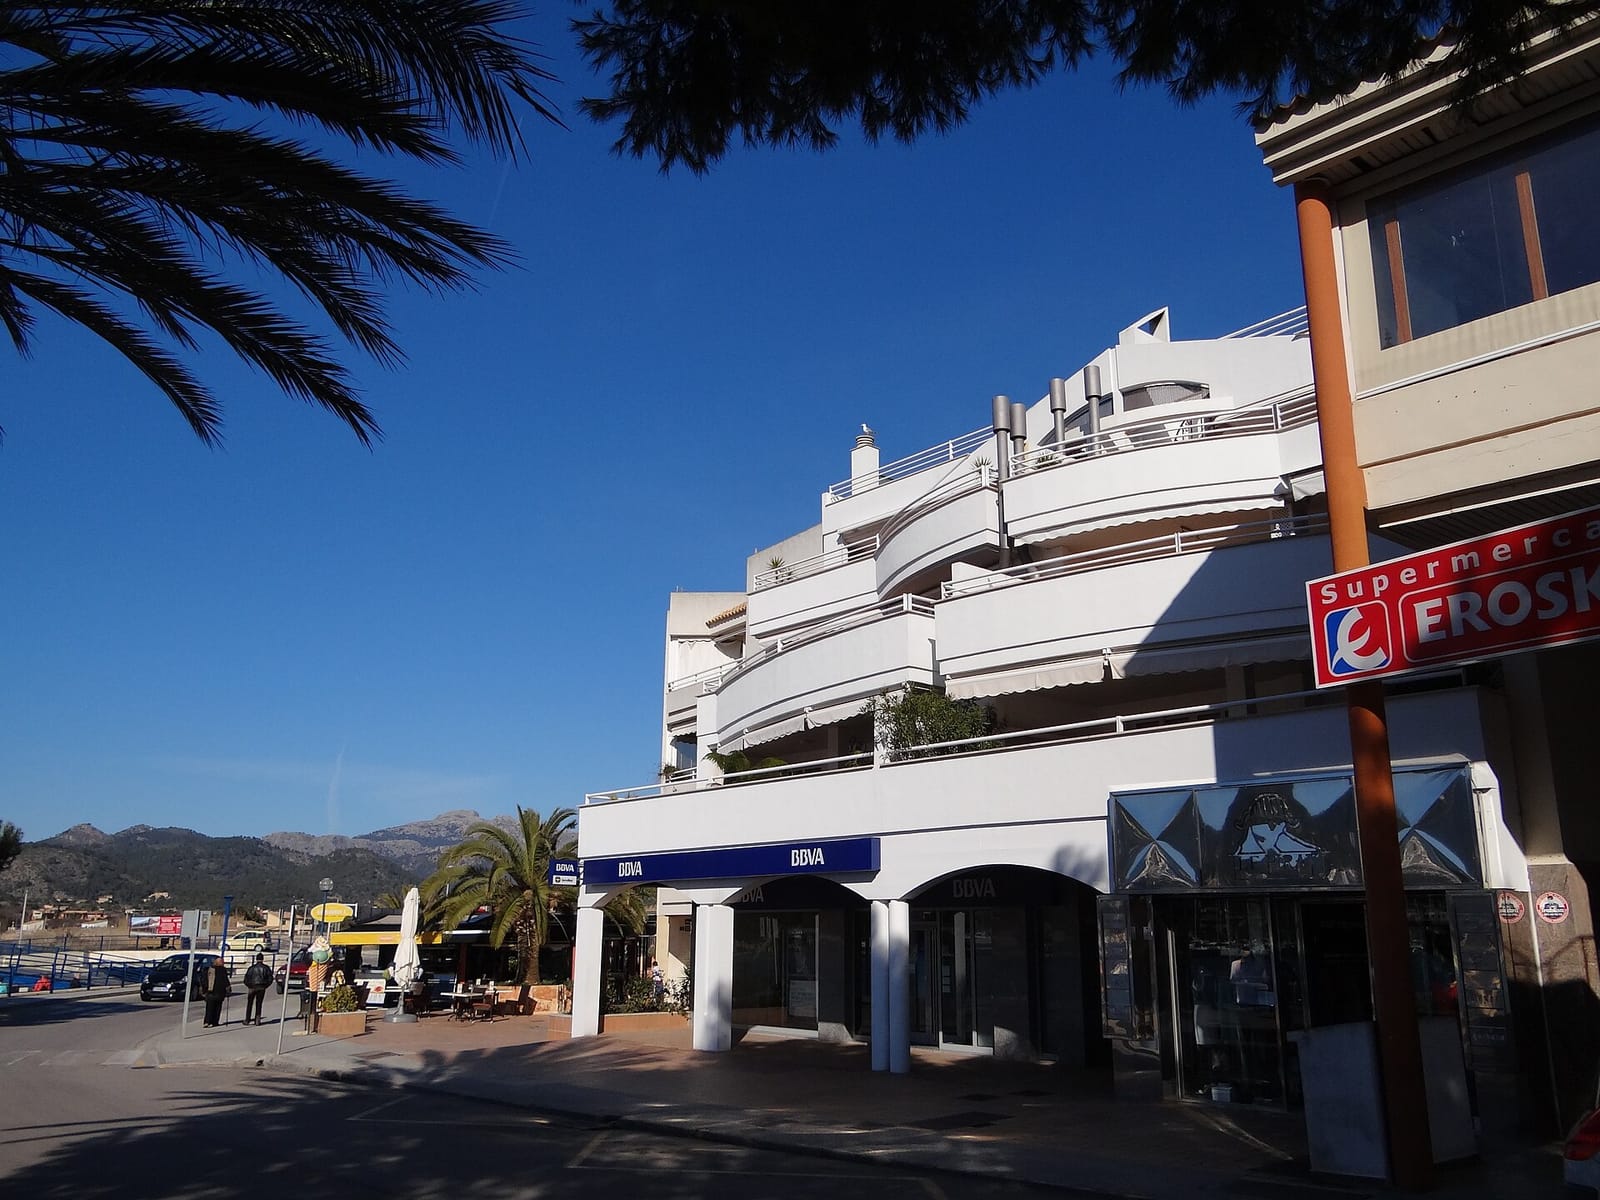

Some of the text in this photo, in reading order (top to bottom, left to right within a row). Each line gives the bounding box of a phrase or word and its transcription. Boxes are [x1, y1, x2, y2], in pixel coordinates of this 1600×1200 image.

[1413, 563, 1600, 644] EROSK
[790, 847, 825, 867] BBVA
[555, 863, 575, 873] BBVA
[618, 861, 643, 877] BBVA
[952, 878, 997, 899] BBVA
